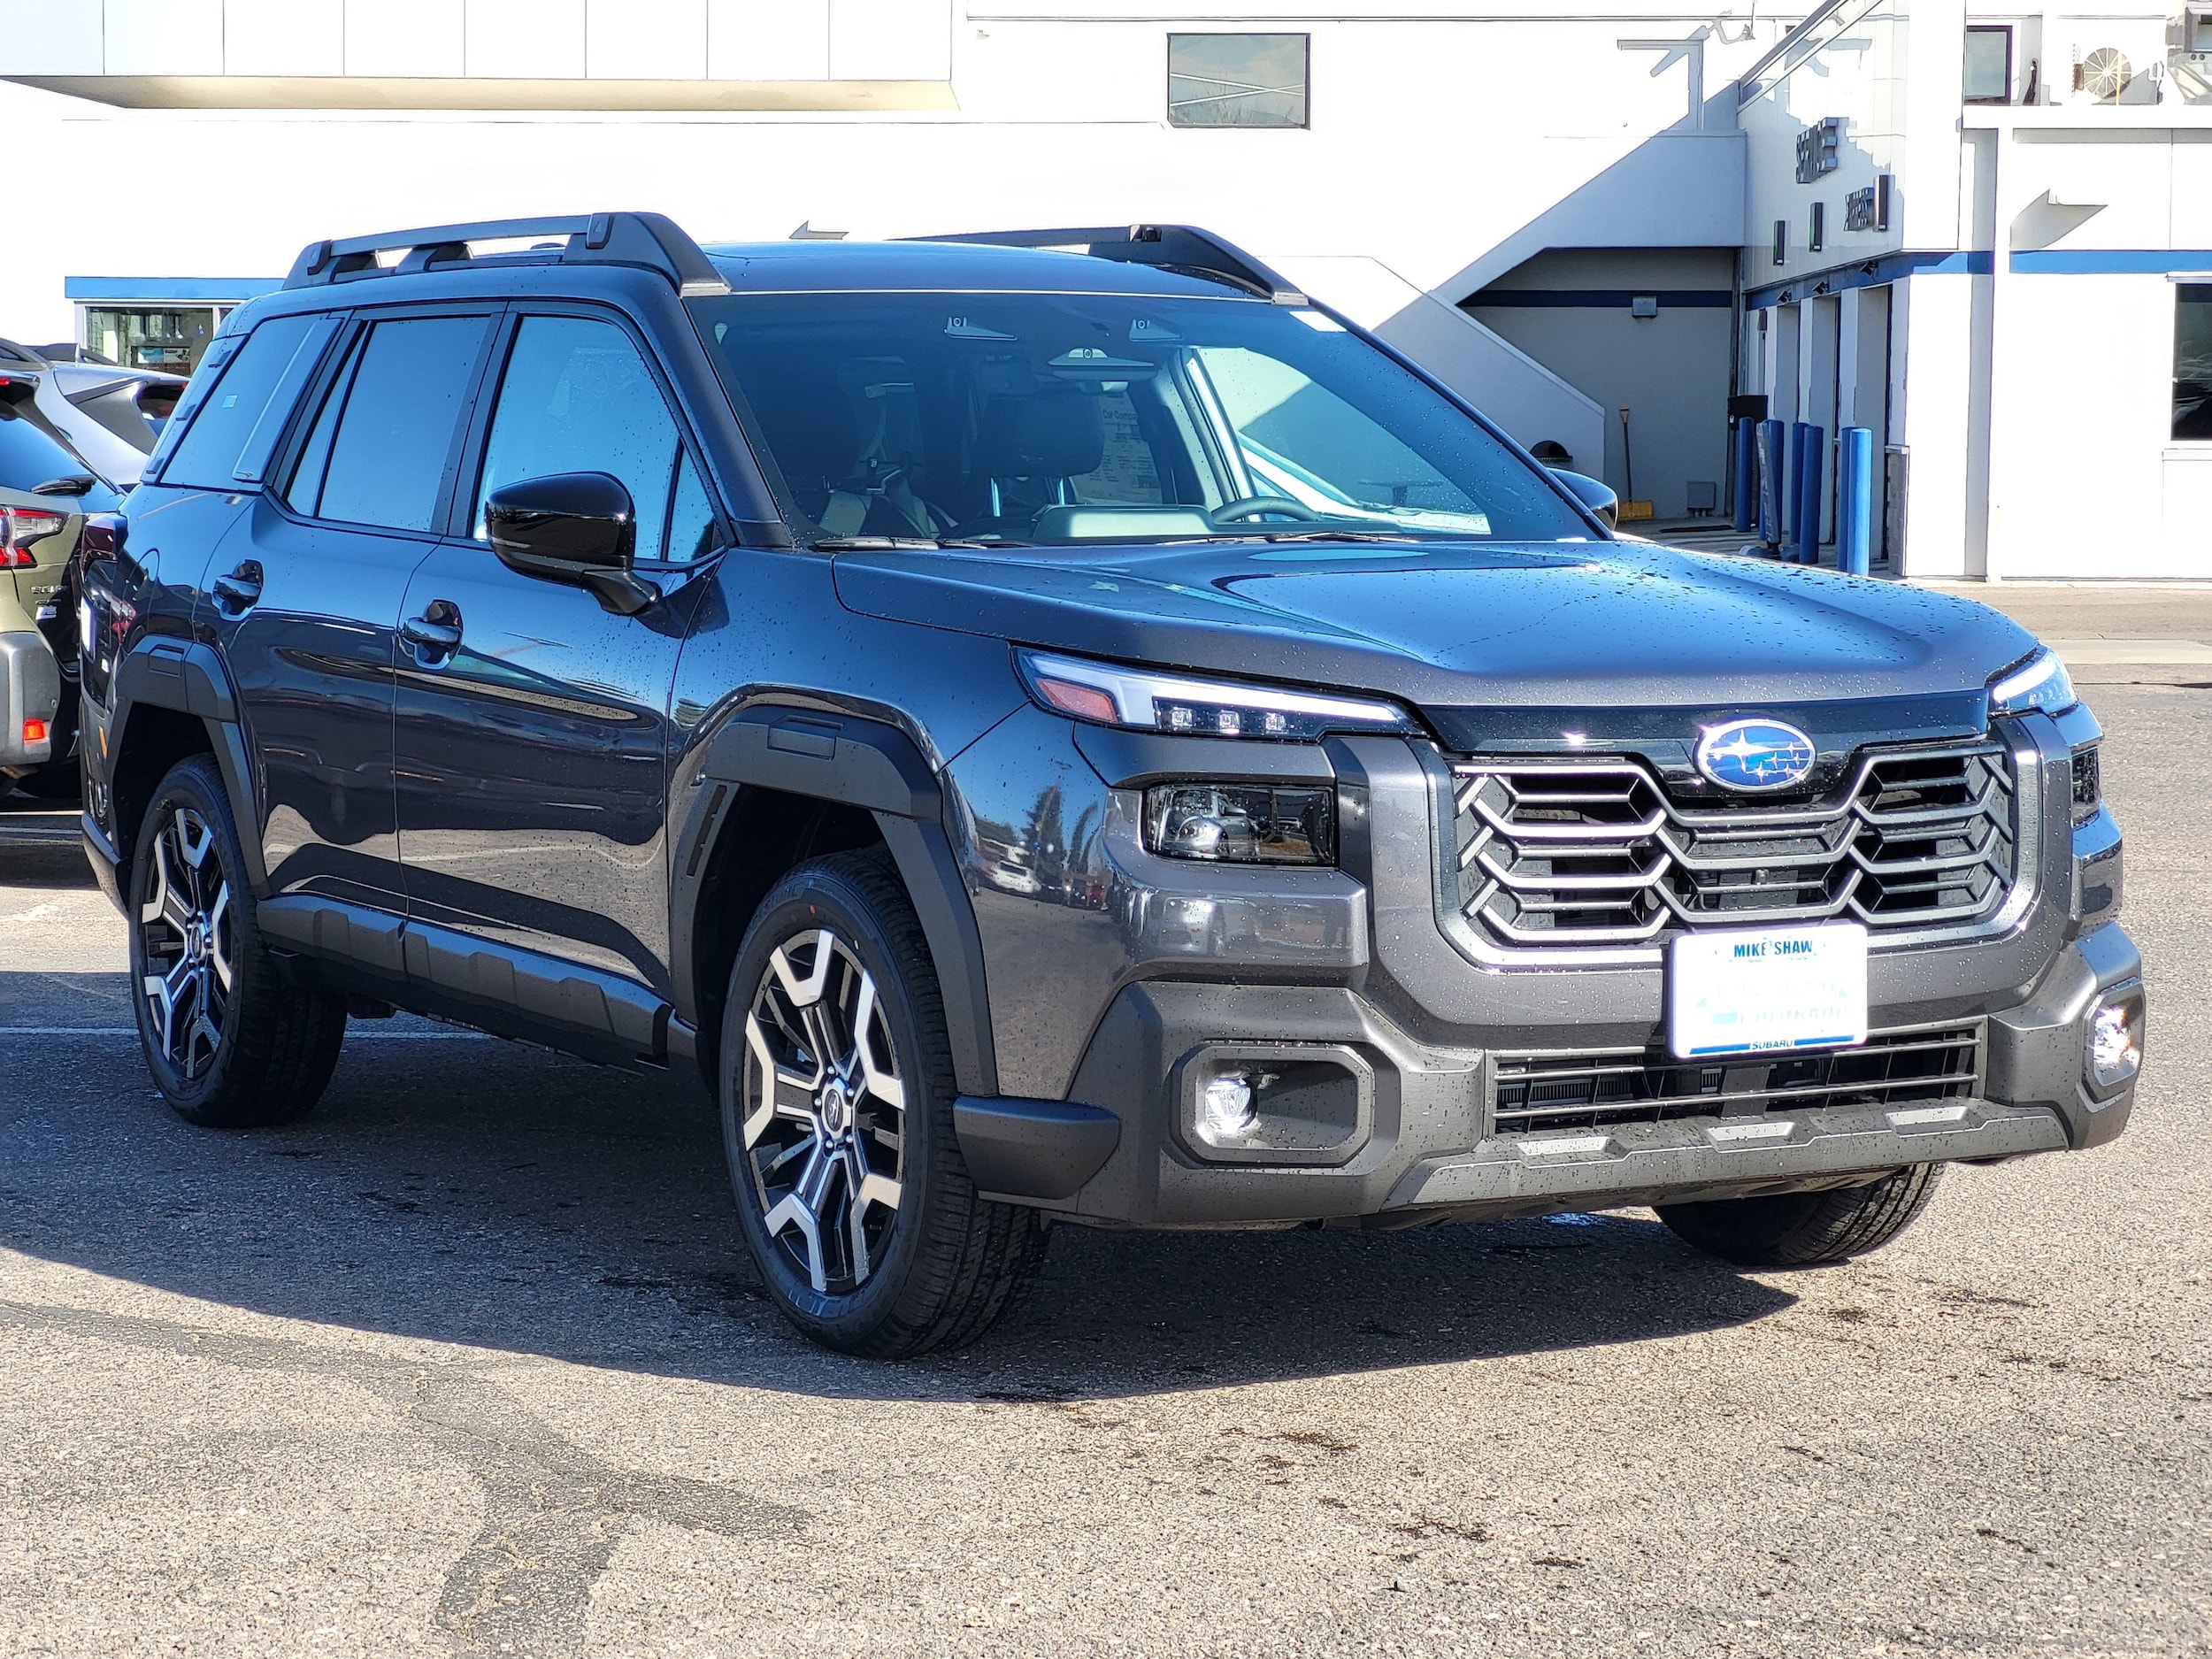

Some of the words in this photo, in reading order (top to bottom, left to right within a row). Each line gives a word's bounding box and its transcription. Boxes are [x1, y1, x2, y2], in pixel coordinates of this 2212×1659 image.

[1734, 942, 1767, 957] MIKE
[1774, 941, 1812, 955] SHAW
[1752, 1040, 1793, 1049] SUBARU
